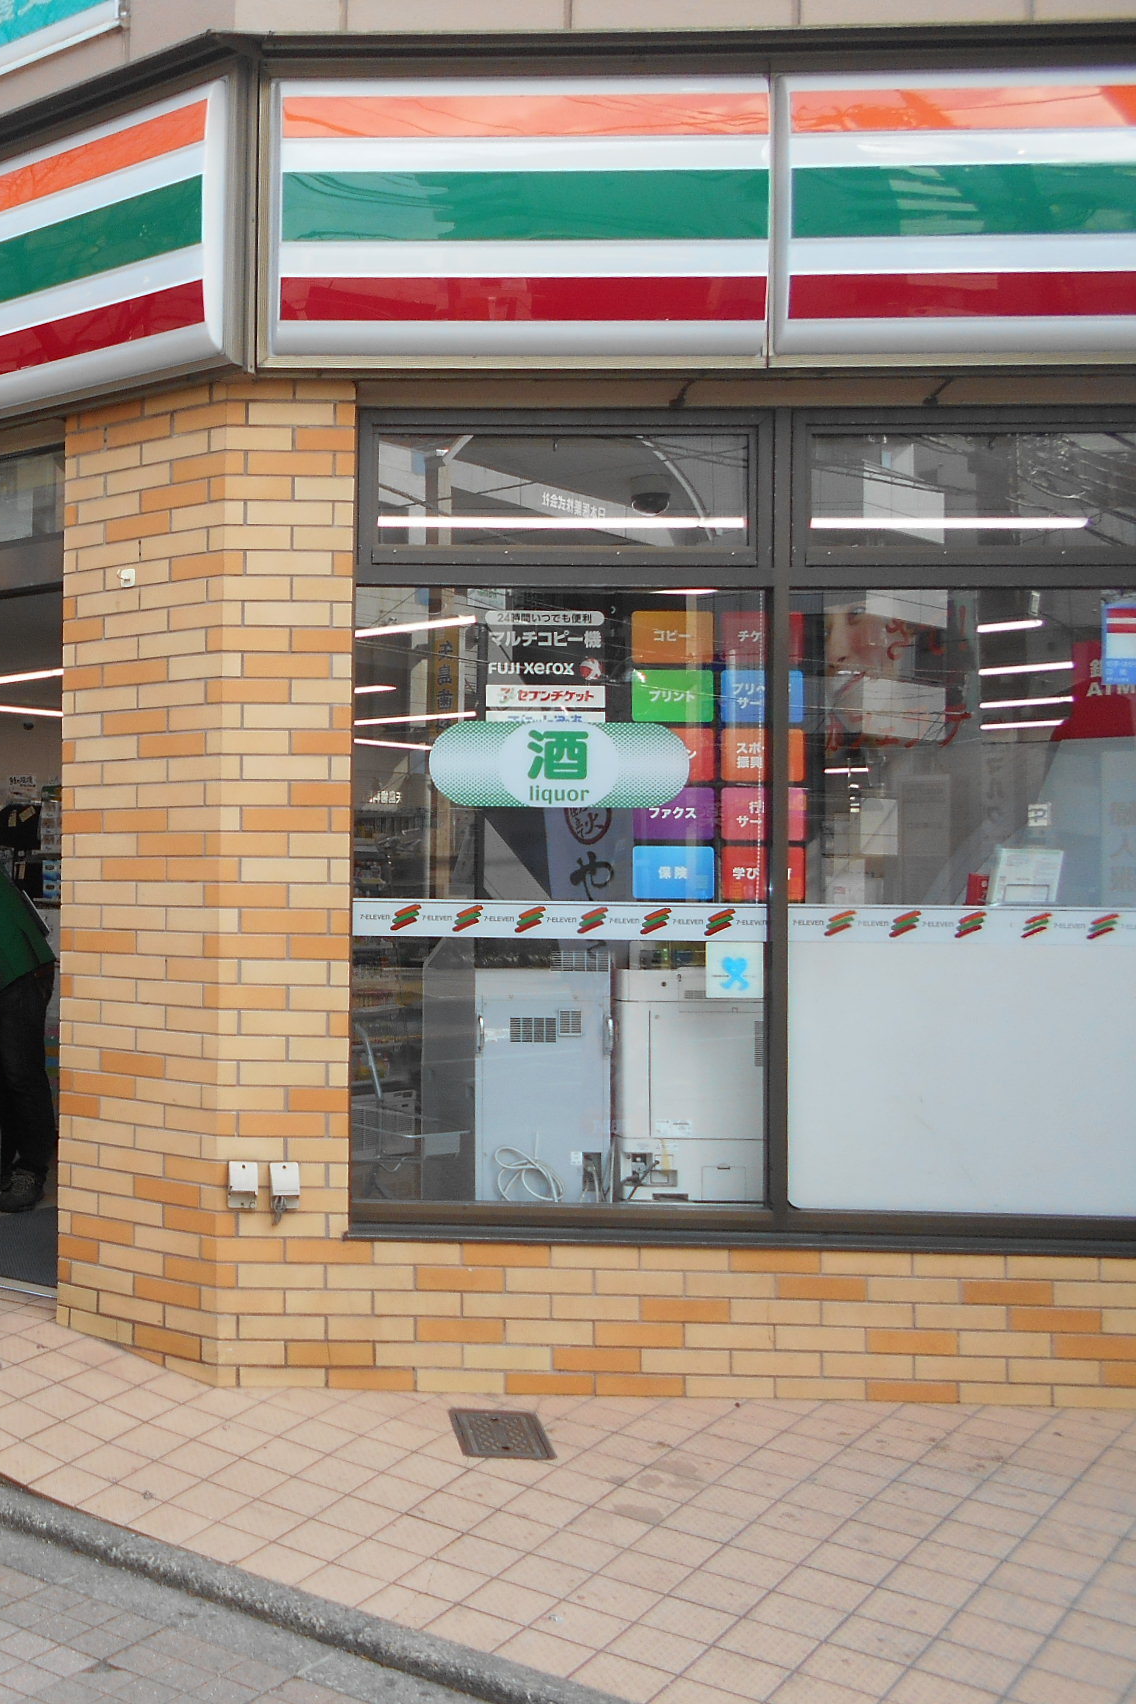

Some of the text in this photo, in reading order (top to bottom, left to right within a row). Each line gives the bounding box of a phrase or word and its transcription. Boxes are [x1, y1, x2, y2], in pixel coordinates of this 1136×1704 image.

[497, 613, 592, 624] 24時間いつでも便利
[489, 630, 602, 648] マルチコピー機
[654, 629, 692, 642] コピー
[518, 690, 594, 702] セブンチケット
[527, 729, 588, 780] 酒
[529, 783, 589, 804] liquor
[649, 807, 697, 819] ファクス
[658, 866, 688, 879] 保険
